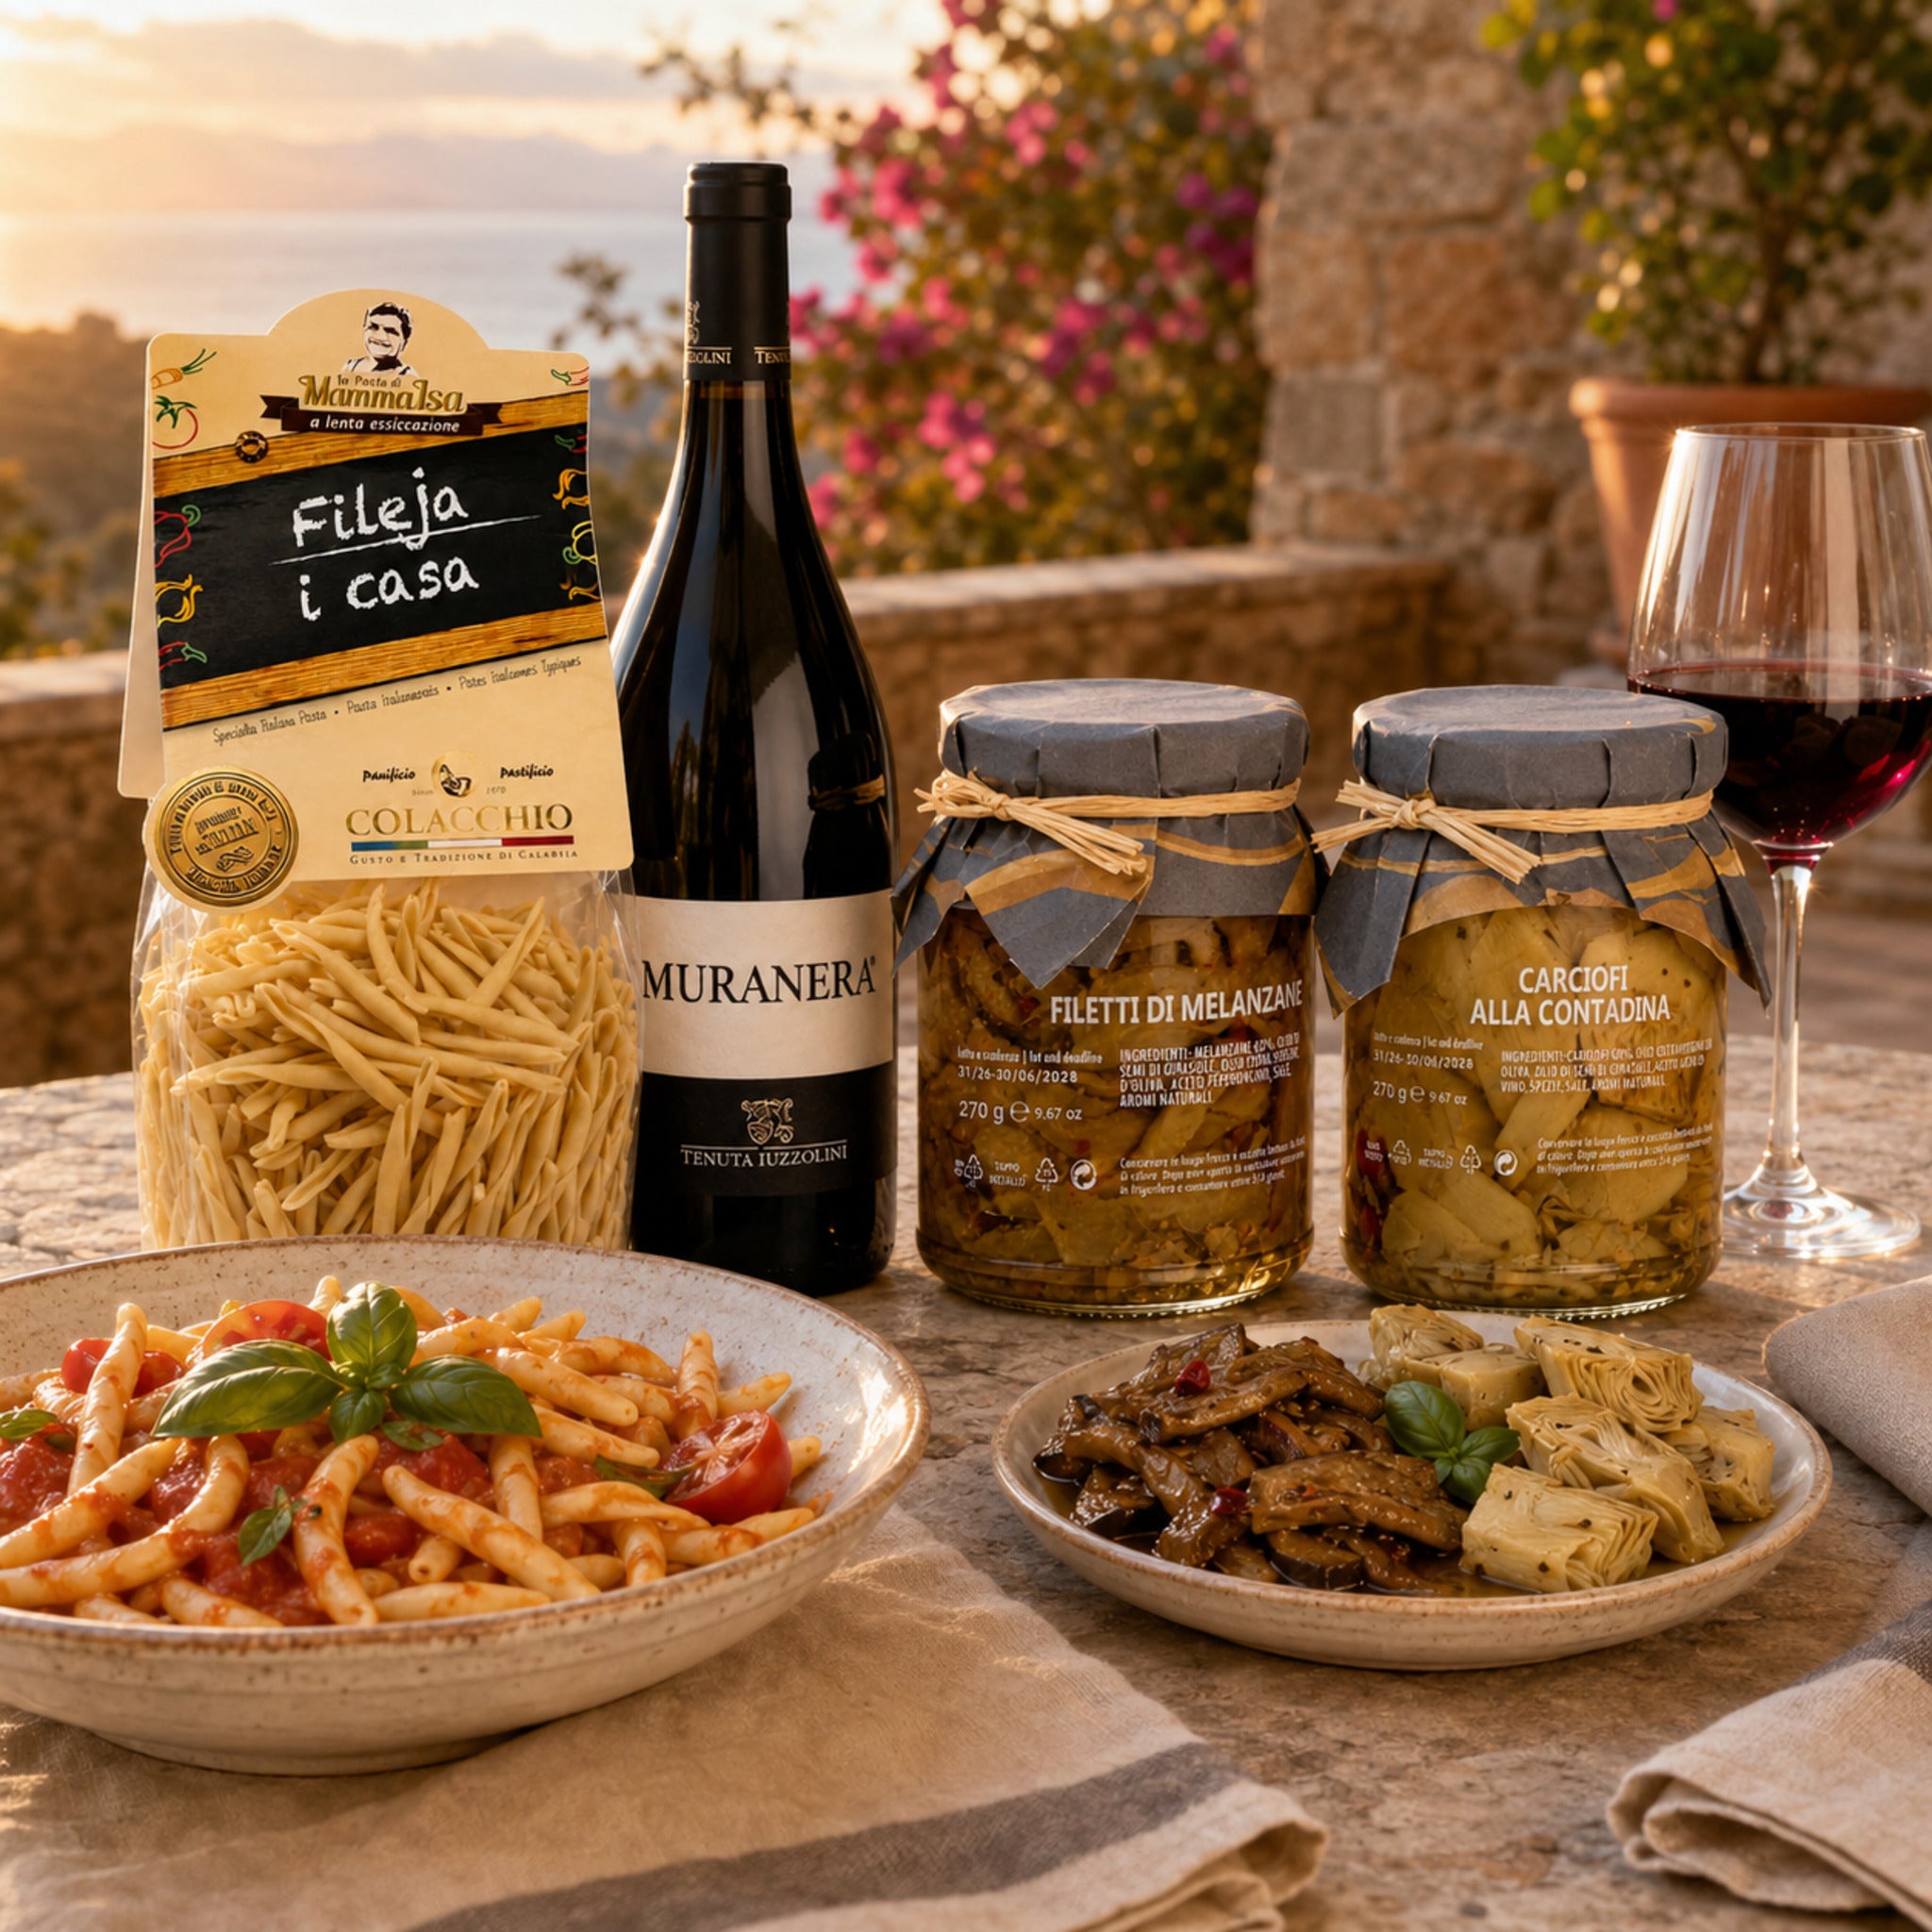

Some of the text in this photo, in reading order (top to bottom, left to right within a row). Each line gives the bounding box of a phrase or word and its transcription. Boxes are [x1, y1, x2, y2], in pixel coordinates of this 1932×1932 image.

[309, 414, 460, 434] a lenta essiccazione
[292, 466, 470, 551] Fileja
[299, 556, 480, 622] i casa
[362, 766, 416, 783] Panificio
[500, 762, 554, 780] Pastificio
[345, 803, 573, 837] COLACCHIO
[399, 855, 407, 863] E
[1519, 965, 1628, 993] CARCIOFI
[1050, 979, 1303, 1024] FILETTI DI MELANZANE
[1470, 994, 1671, 1025] ALLA CONTADINA
[958, 1065, 1078, 1084] 31/26-30/06/2028
[1120, 1091, 1213, 1108] AROMI NATURALI
[1373, 1081, 1395, 1099] 270
[1398, 1088, 1407, 1104] g
[958, 1099, 989, 1119] 270
[992, 1105, 1004, 1124] g
[1034, 1107, 1062, 1120] 9.67
[1065, 1108, 1084, 1121] oz
[679, 1144, 847, 1168] TENUTA IUZZOLINI
